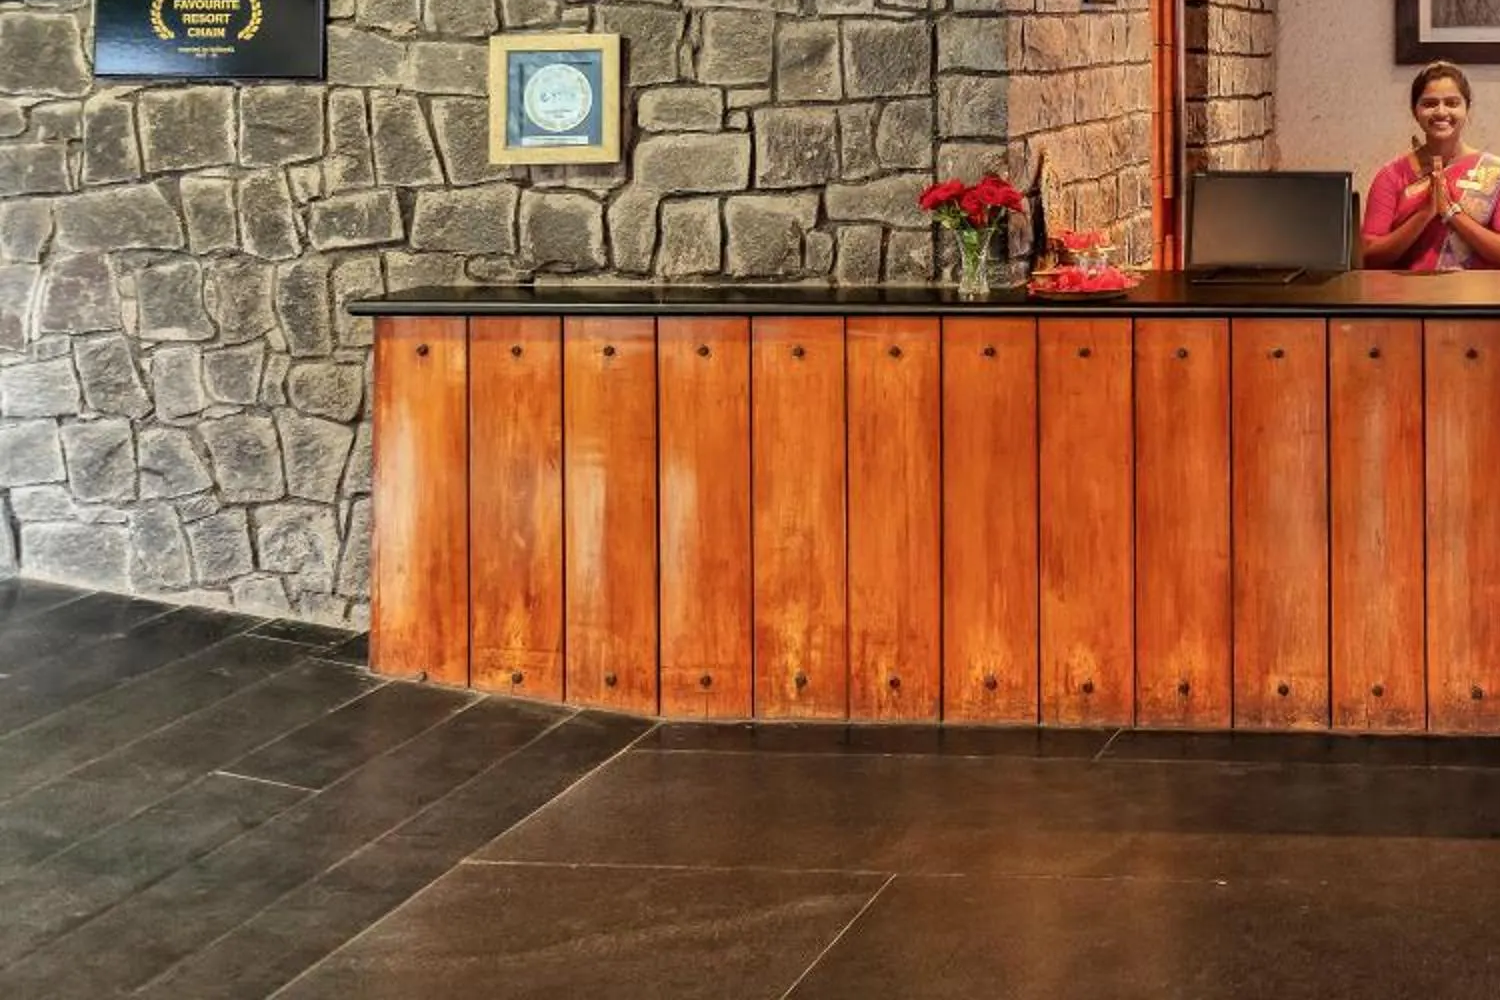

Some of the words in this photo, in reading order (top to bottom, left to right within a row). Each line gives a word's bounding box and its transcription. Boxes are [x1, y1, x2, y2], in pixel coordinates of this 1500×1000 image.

[173, 0, 240, 9] FAVOURITE
[183, 13, 231, 23] RESORT
[187, 27, 225, 37] CHAIN
